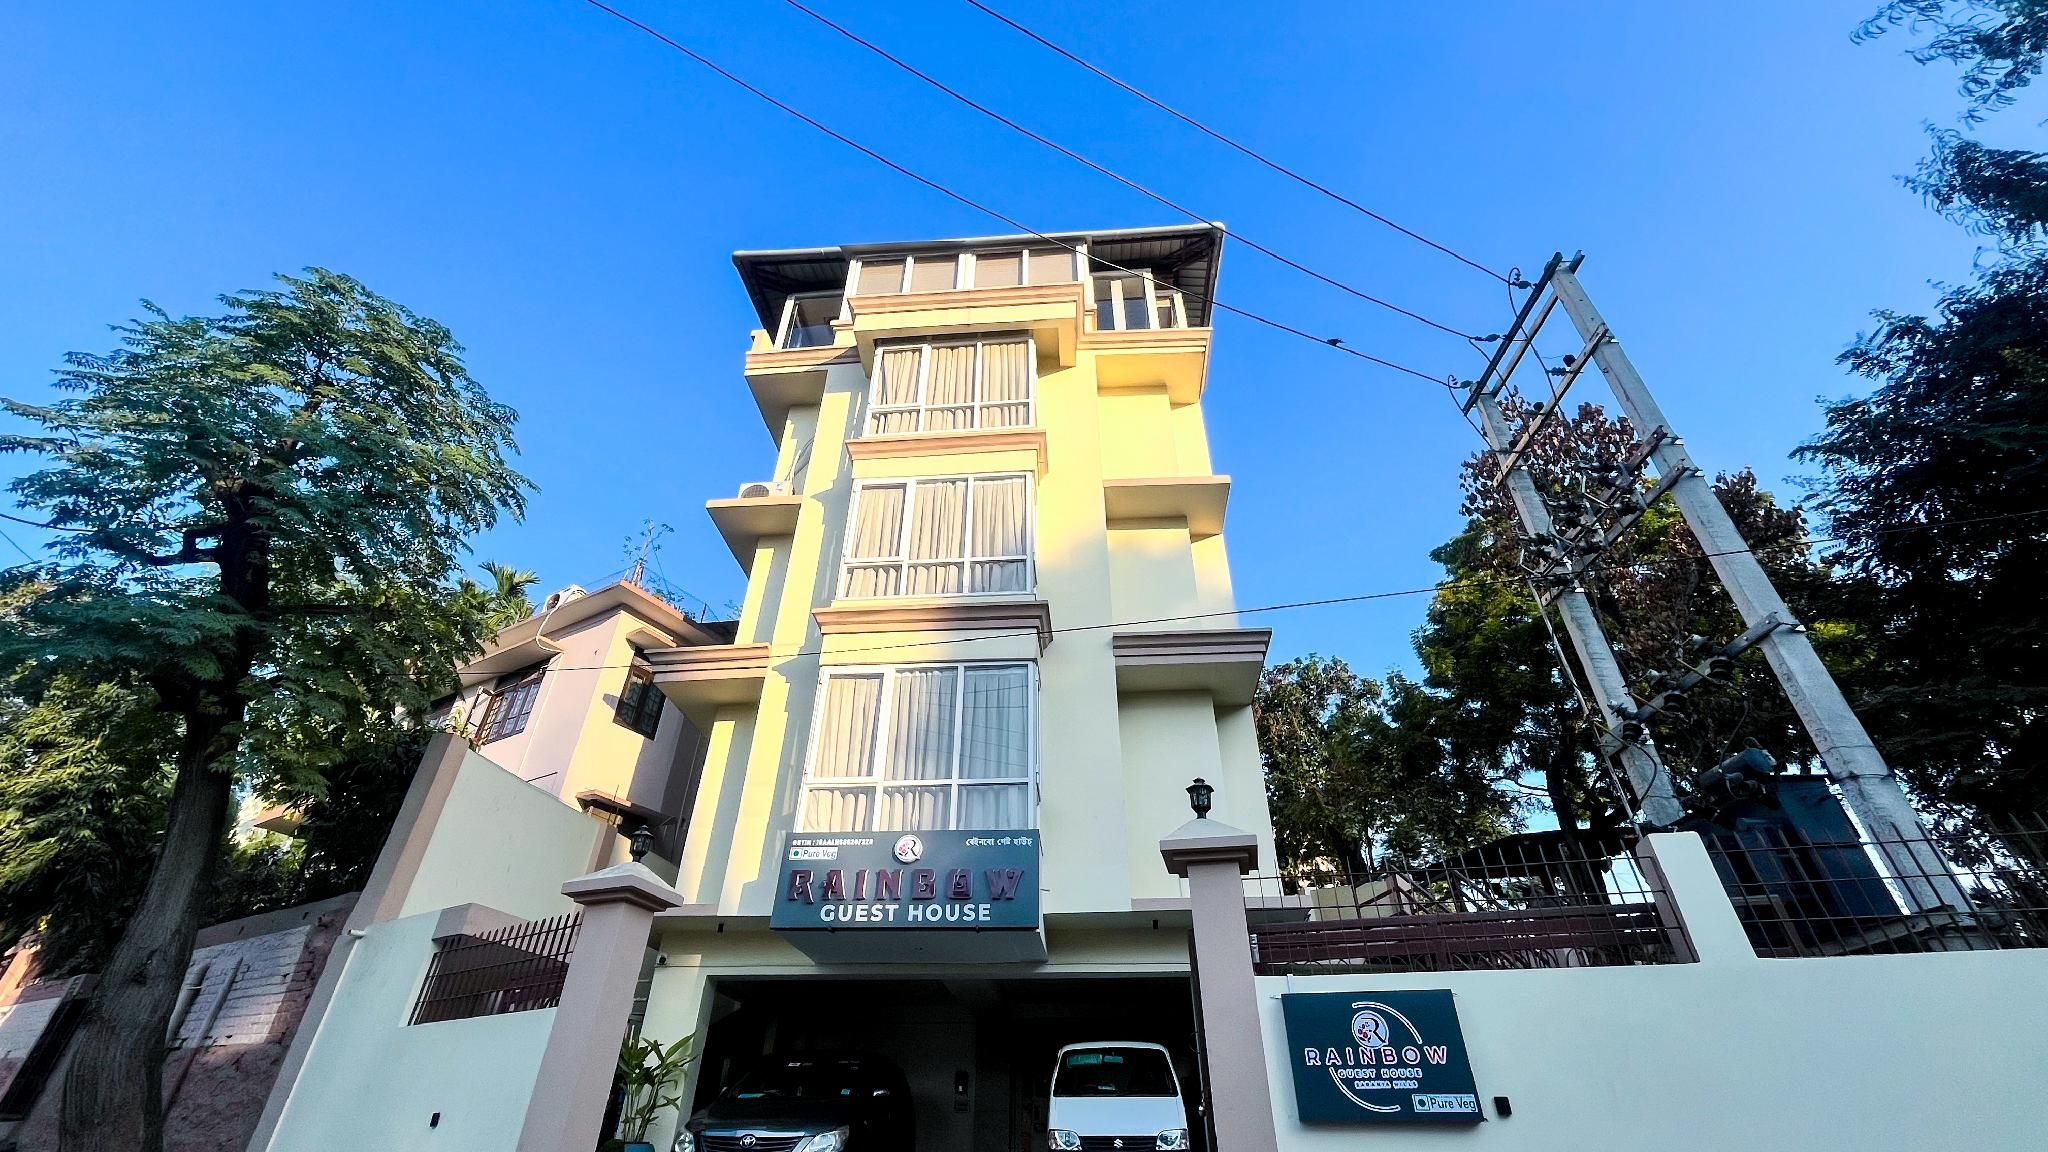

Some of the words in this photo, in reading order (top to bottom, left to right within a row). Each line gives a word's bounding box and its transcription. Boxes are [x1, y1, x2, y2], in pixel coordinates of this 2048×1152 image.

[803, 849, 820, 858] Pure
[822, 849, 837, 859] Veg
[788, 868, 1025, 903] RAINBOW
[820, 903, 899, 922] GUEST
[907, 903, 992, 921] HOUSE
[1304, 1045, 1447, 1066] RAINBOW
[1337, 1068, 1377, 1079] GUEST
[1381, 1067, 1423, 1078] HOUSE
[1393, 1080, 1418, 1089] HILLS
[1429, 1097, 1454, 1109] Pure
[1456, 1097, 1477, 1112] Veg
